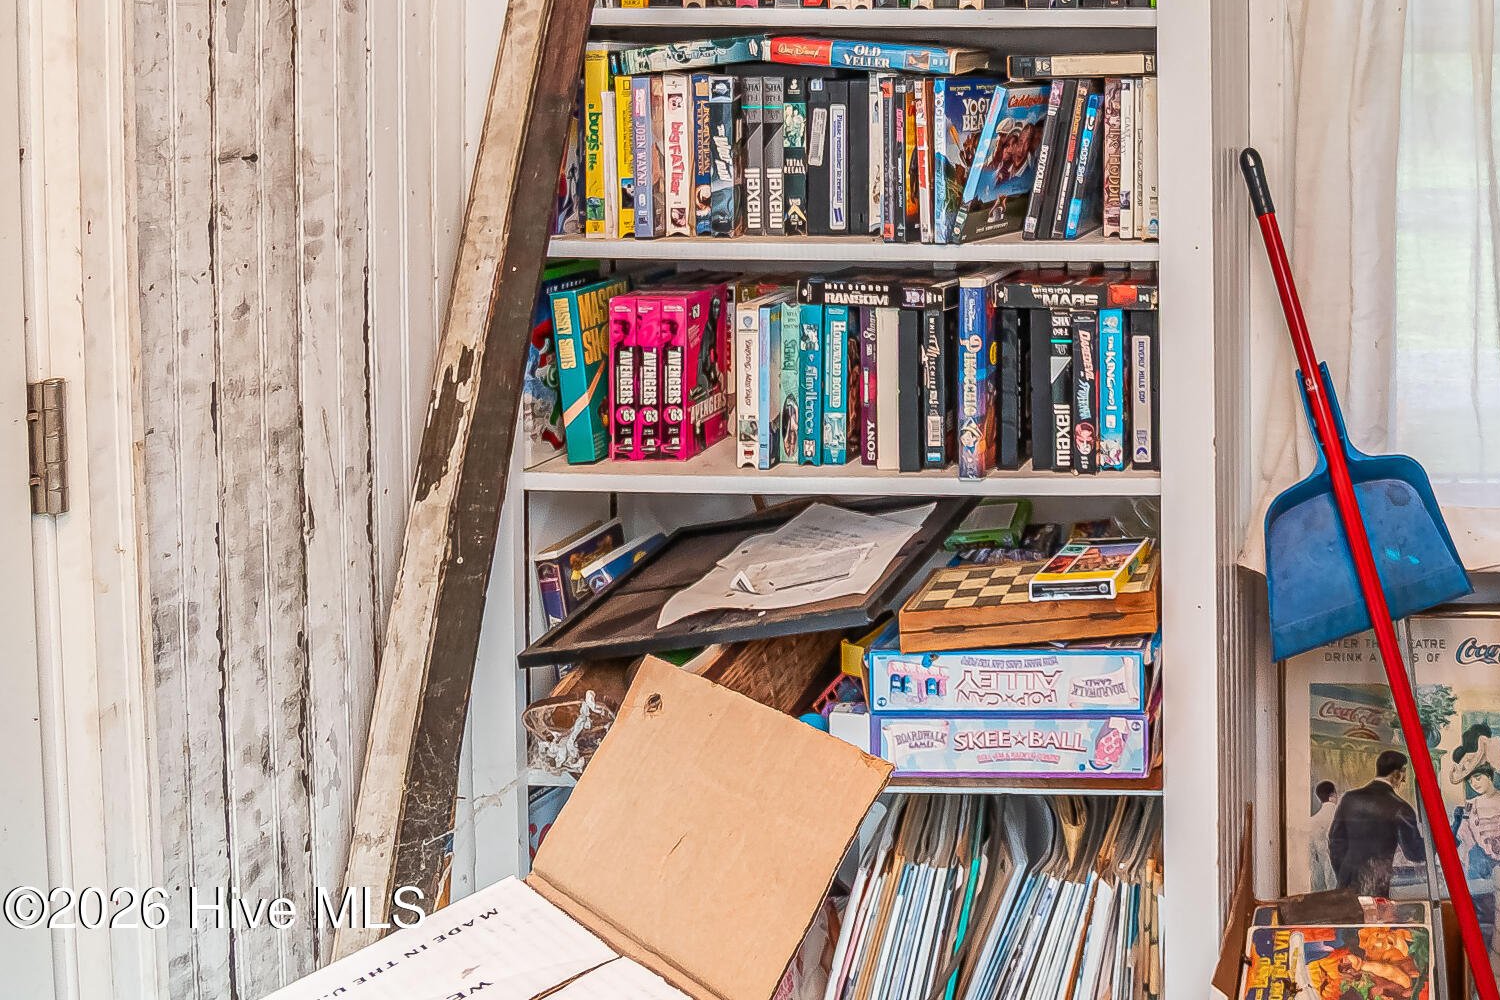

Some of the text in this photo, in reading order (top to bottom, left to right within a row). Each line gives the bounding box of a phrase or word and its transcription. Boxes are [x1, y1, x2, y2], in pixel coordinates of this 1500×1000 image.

[843, 53, 891, 69] YELLER
[853, 44, 882, 57] OLD
[935, 90, 945, 154] YOGI BEAR
[961, 98, 991, 115] YOGI
[835, 115, 843, 135] Please
[636, 121, 647, 187] JOHN WAYNE
[835, 136, 843, 169] remember
[1033, 144, 1049, 194] BODY DOUBLE
[1076, 138, 1091, 184] GHOST SHIP
[743, 167, 761, 229] maxell
[766, 167, 783, 229] maxell
[825, 292, 890, 306] RANSOM
[1042, 293, 1098, 307] MARS
[928, 317, 936, 344] WHITE
[832, 320, 847, 408] HOMEWARD BOUND
[1078, 329, 1095, 381] DAREDEVIL
[1105, 350, 1117, 388] KING
[619, 351, 633, 405] AVENGERS
[643, 352, 657, 405] AVENGERS
[668, 351, 682, 404] AVENGERS
[960, 334, 983, 417] PINOCCHIO
[1138, 391, 1146, 404] COP
[866, 420, 876, 461] SONY
[1053, 403, 1071, 466] maxell
[1324, 652, 1362, 663] DRINK
[1426, 652, 1441, 663] OF
[954, 670, 1064, 690] ALLEY
[955, 688, 1058, 706] POP CAN
[1070, 682, 1127, 698] BOARDWALK
[894, 730, 947, 748] BOARDWALK
[953, 729, 1087, 752] SKEE BALL
[351, 907, 499, 987] MADE IN THE
